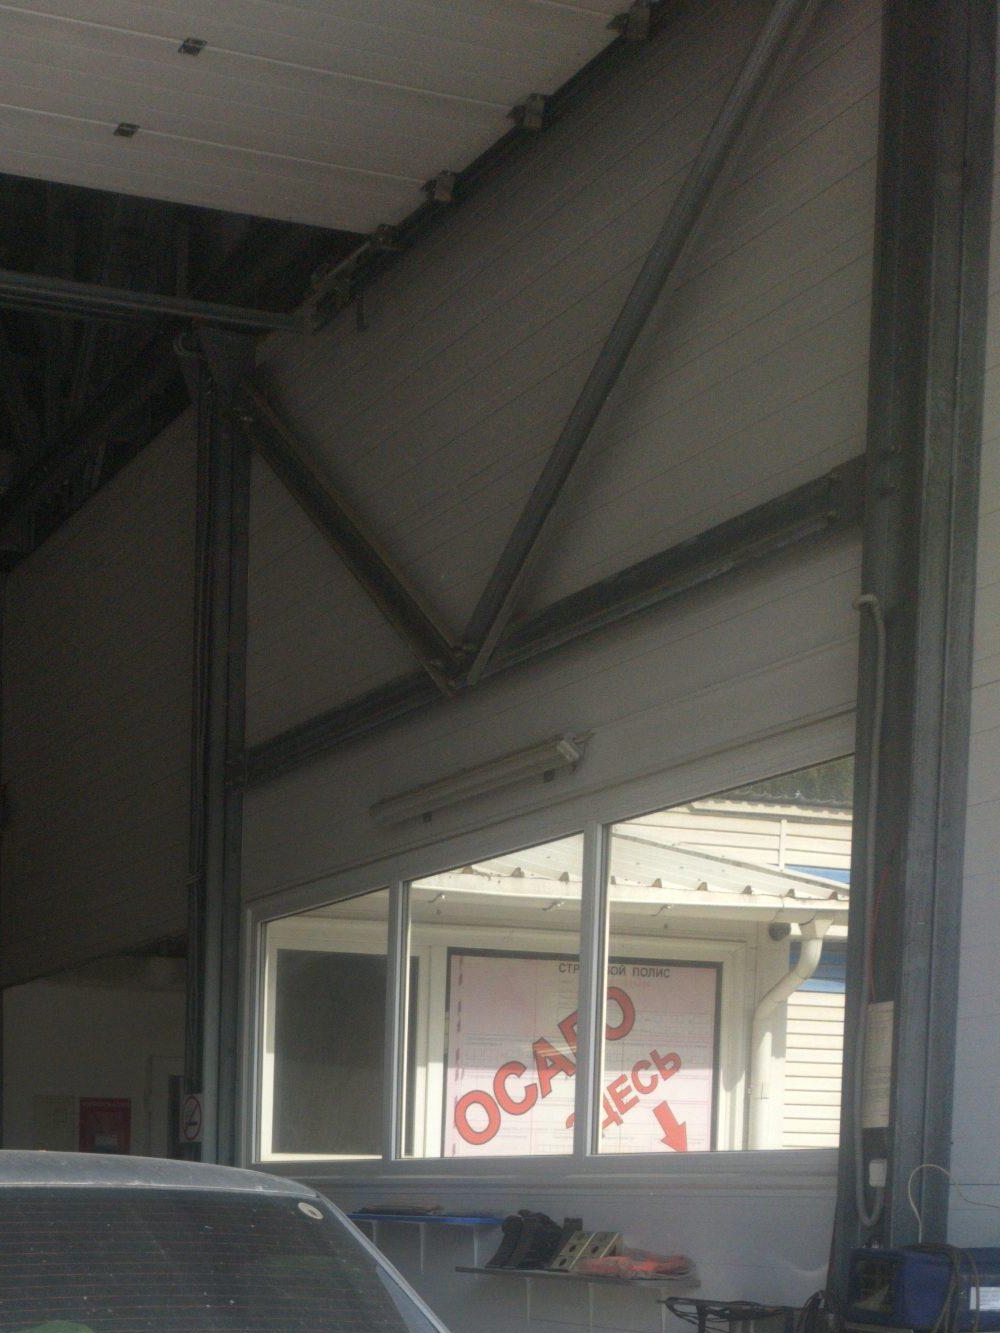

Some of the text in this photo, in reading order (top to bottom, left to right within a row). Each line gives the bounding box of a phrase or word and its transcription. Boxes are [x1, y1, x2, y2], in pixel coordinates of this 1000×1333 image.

[558, 962, 671, 978] СТРОЙ ПОЛИС
[566, 1049, 682, 1138] ДЕСЬ
